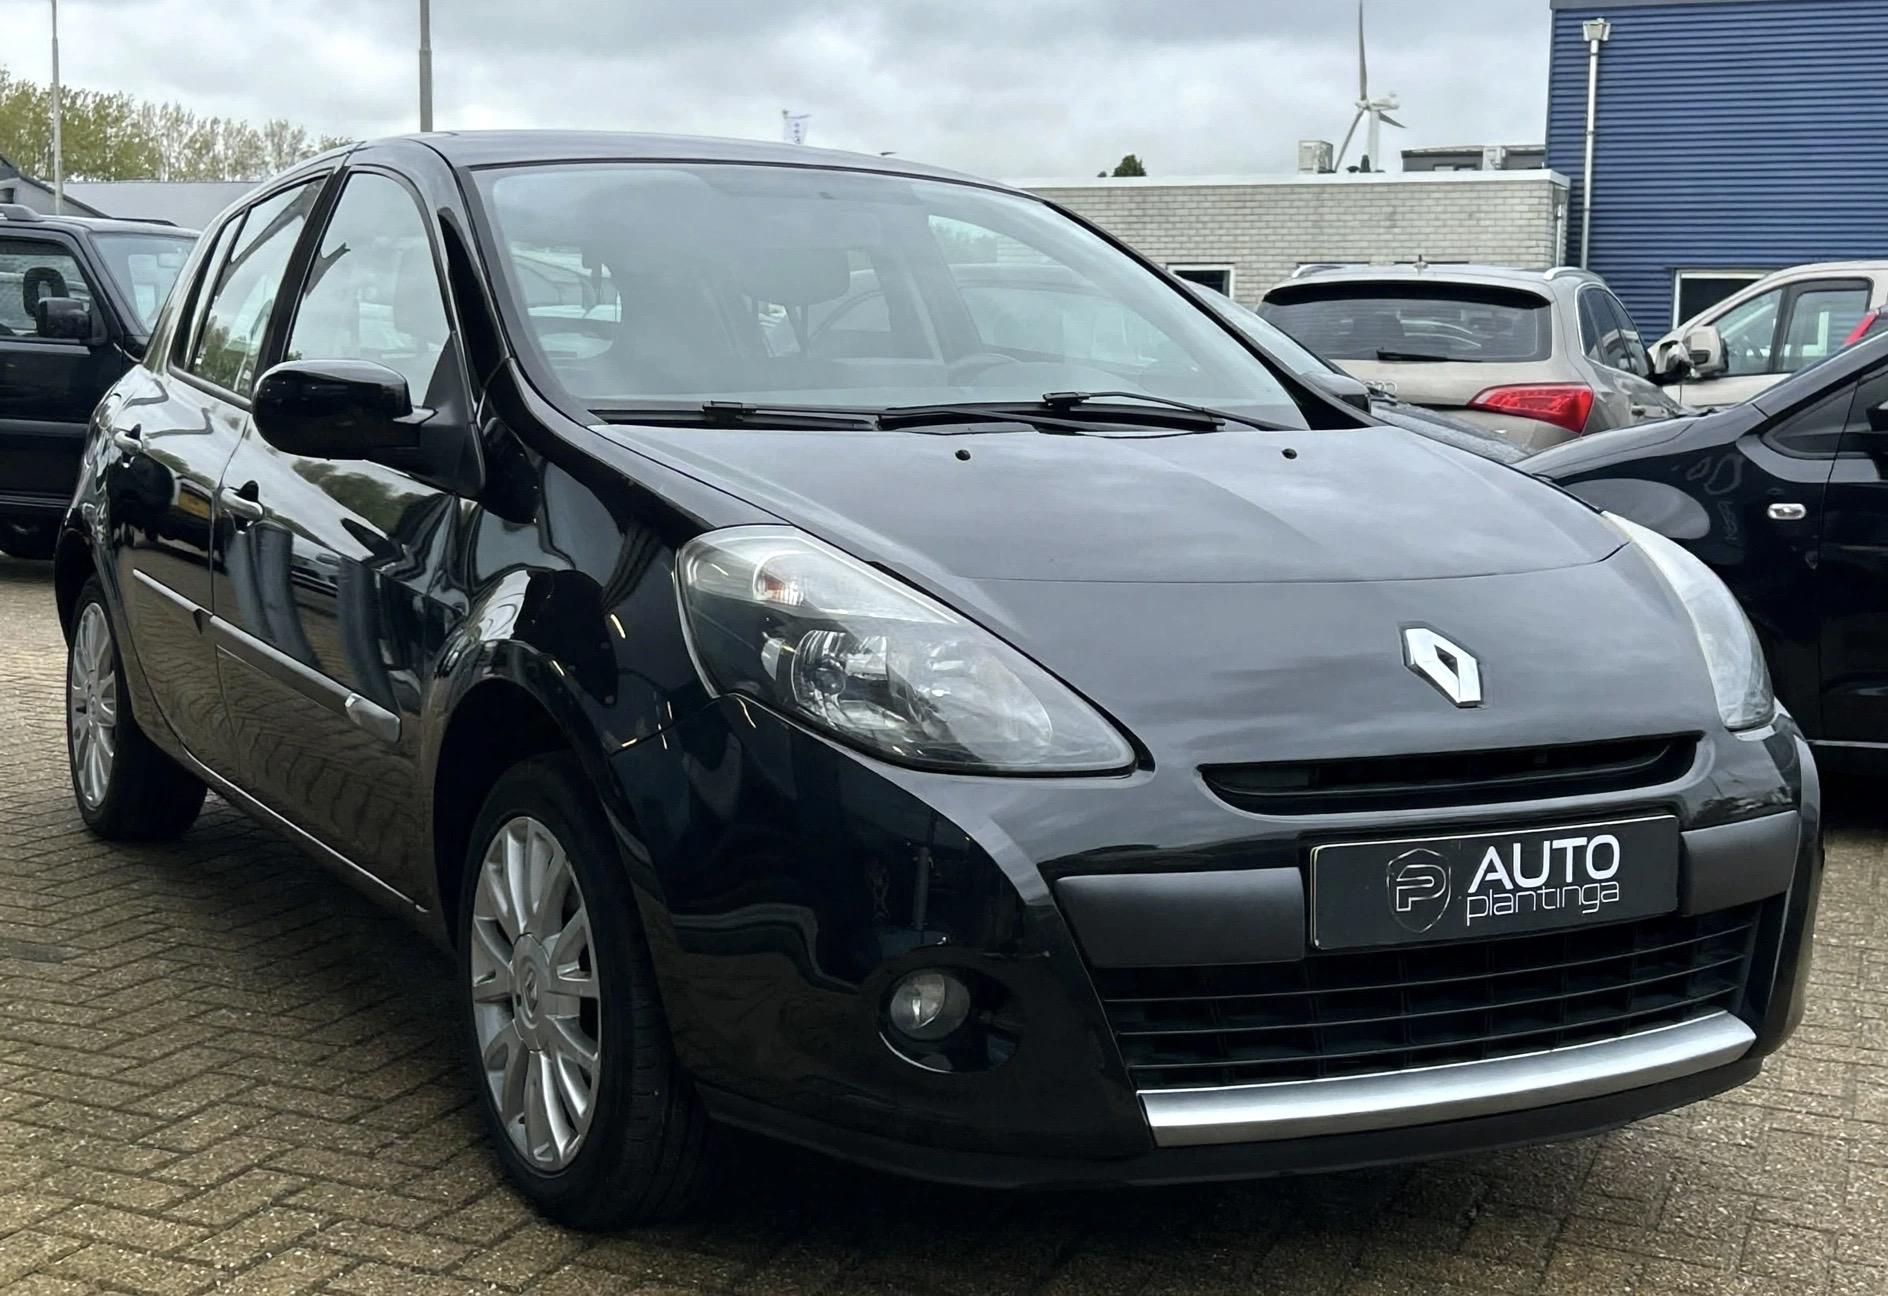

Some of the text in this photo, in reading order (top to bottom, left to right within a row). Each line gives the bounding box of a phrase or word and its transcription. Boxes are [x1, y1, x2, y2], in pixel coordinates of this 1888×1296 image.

[1467, 834, 1620, 893] AUTO
[1396, 864, 1447, 912] P
[1466, 880, 1620, 926] plantinga
